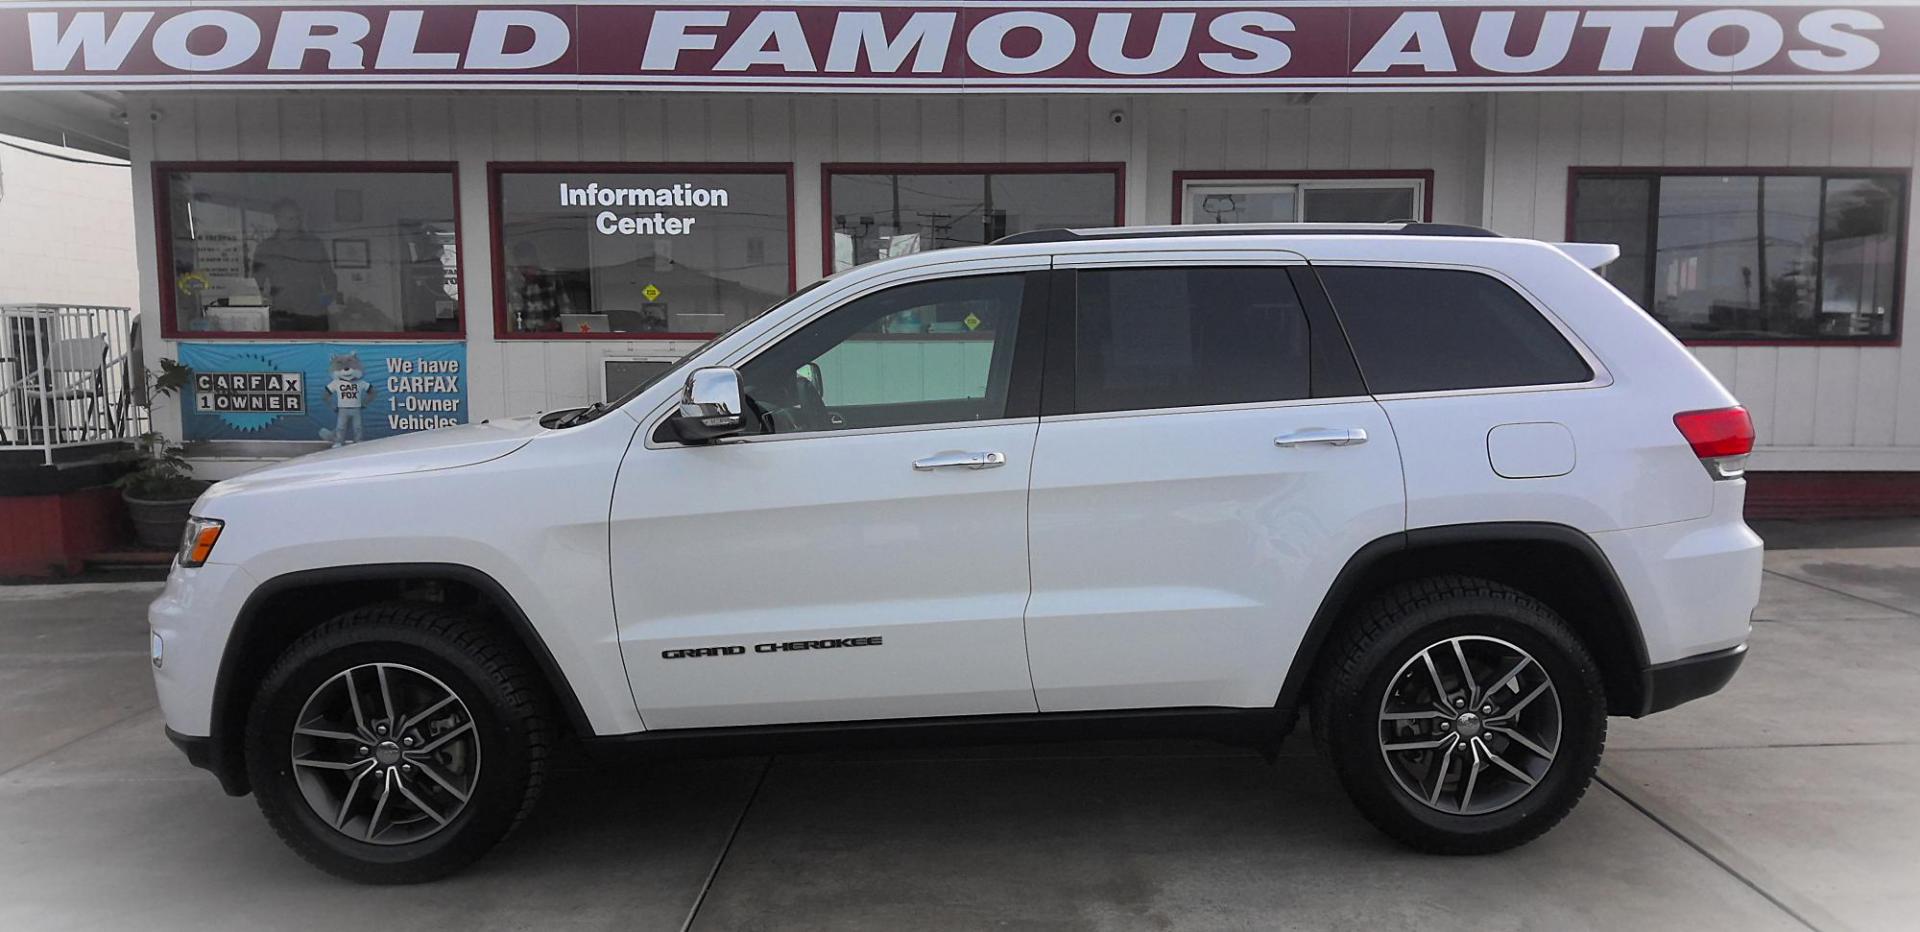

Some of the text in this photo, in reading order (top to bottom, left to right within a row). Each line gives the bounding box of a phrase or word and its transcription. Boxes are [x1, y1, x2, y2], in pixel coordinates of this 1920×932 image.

[27, 8, 1885, 75] WORLD FAMOUS AUTOS
[559, 182, 729, 207] Information
[596, 211, 696, 235] Center
[386, 357, 459, 374] We have
[198, 374, 300, 392] CARFAX
[387, 376, 458, 393] CARFAX
[201, 395, 299, 409] 1 OWNER
[388, 396, 460, 412] 1-Owner
[388, 414, 459, 430] Vehicles
[661, 636, 883, 660] GRAND CHEROKEE
